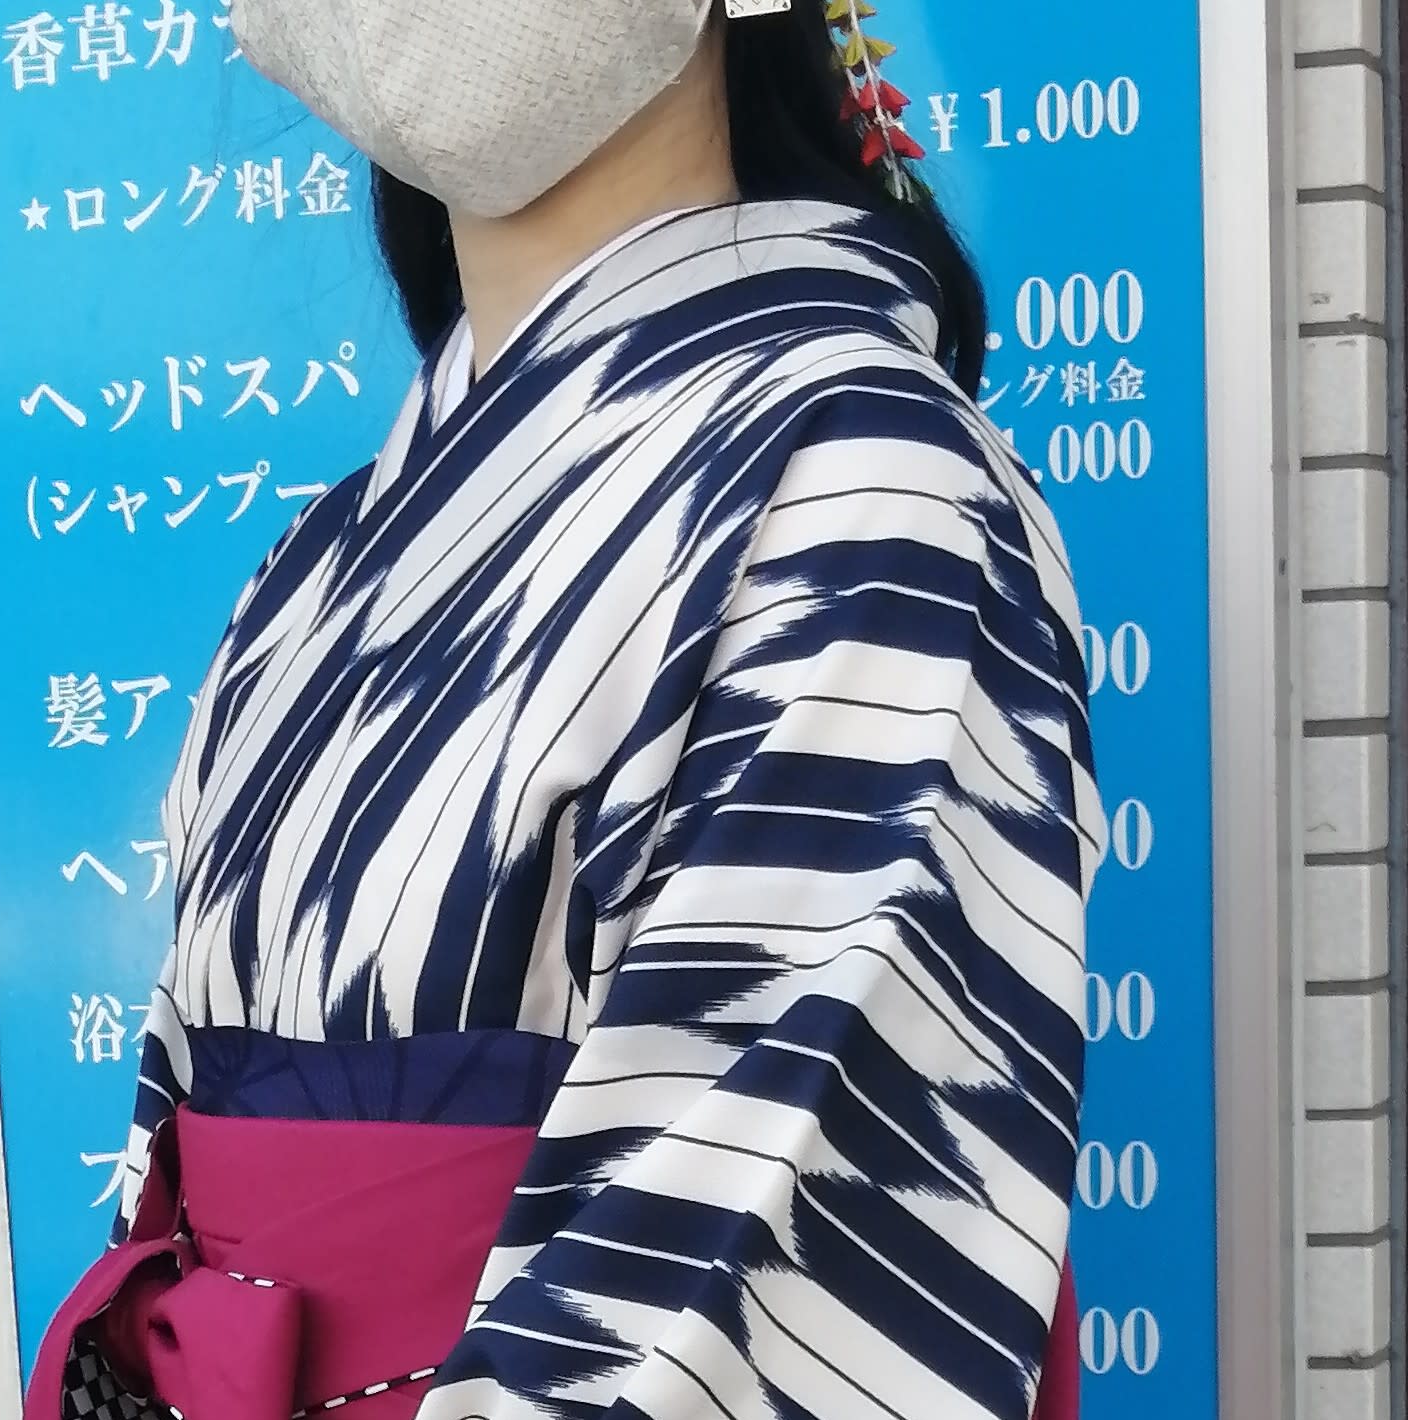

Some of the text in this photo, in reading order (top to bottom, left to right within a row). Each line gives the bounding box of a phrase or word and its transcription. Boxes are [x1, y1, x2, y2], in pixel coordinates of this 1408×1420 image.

[19, 341, 361, 432] ヘッドスパ
